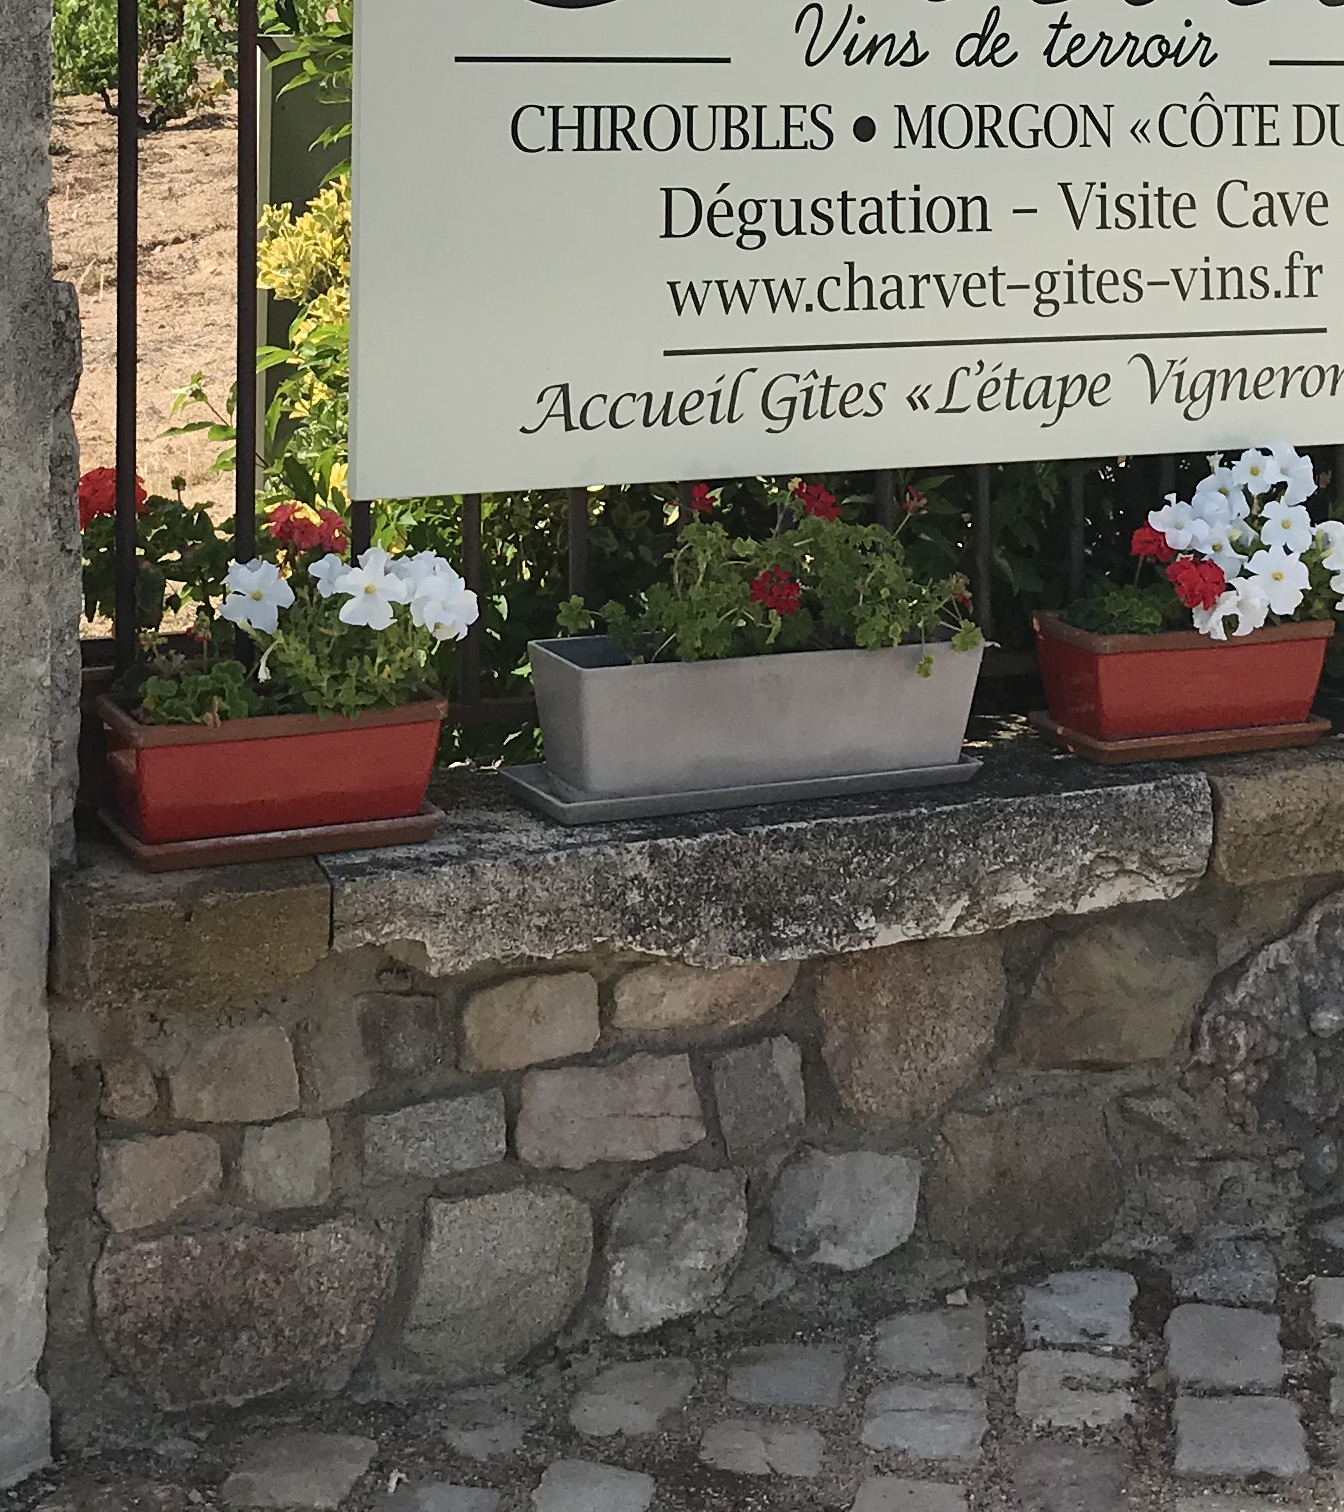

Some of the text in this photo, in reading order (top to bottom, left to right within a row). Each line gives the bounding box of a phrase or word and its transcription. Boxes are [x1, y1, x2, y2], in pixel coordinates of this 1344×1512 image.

[794, 2, 1219, 69] Vins de terroir
[510, 104, 834, 154] CHIROUBLES
[893, 103, 1115, 150] MORGON
[1129, 91, 1280, 148] «CÔTE
[659, 182, 993, 251] Dégustation
[1056, 181, 1197, 231] Visite
[1216, 179, 1329, 229] Cave
[666, 250, 1324, 318] www.charvet-gites-vins.fr
[518, 367, 759, 435] Accueil
[761, 368, 887, 434] Gîtes
